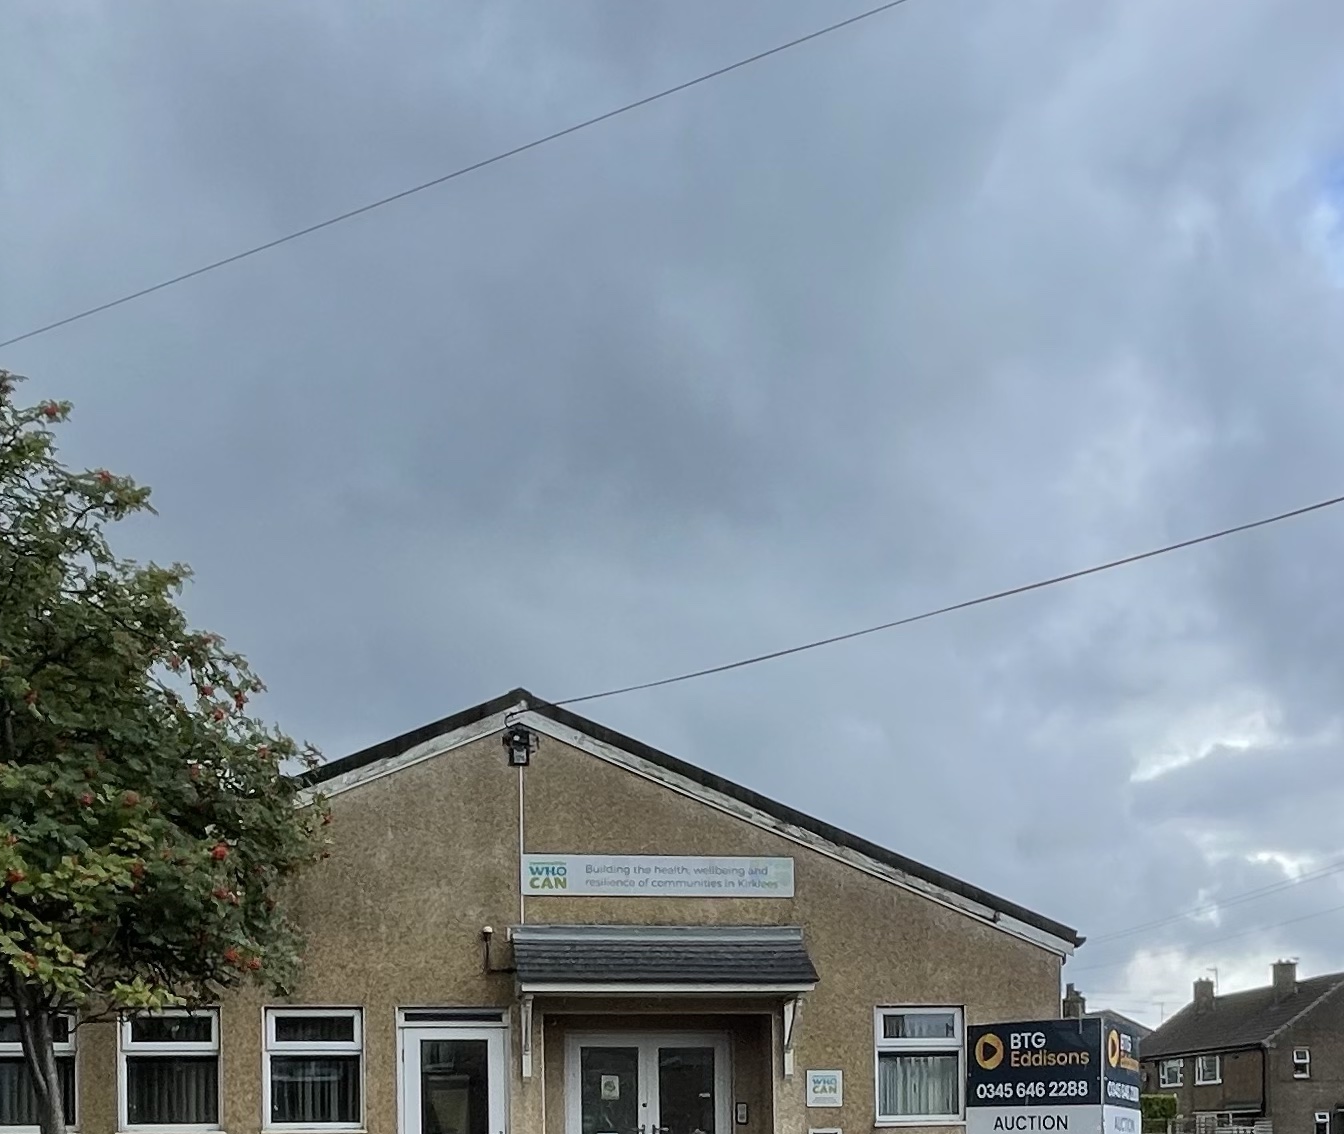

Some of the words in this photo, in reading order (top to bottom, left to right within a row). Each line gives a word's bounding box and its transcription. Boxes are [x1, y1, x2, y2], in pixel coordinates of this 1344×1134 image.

[529, 866, 567, 876] WHO
[585, 864, 630, 876] Building
[633, 864, 651, 874] the
[692, 865, 745, 877] wellbeing
[748, 866, 768, 875] and
[529, 877, 567, 889] CAN
[585, 878, 635, 887] resilience
[638, 877, 649, 887] of
[651, 878, 722, 888] communities
[724, 878, 735, 888] in
[1010, 1031, 1046, 1049] BTG
[1010, 1049, 1090, 1068] Eddisons
[812, 1085, 837, 1094] CAN
[976, 1082, 1014, 1099] 0345
[1016, 1081, 1046, 1098] 646
[1048, 1080, 1089, 1097] 2288
[993, 1115, 1069, 1131] AUCTION
